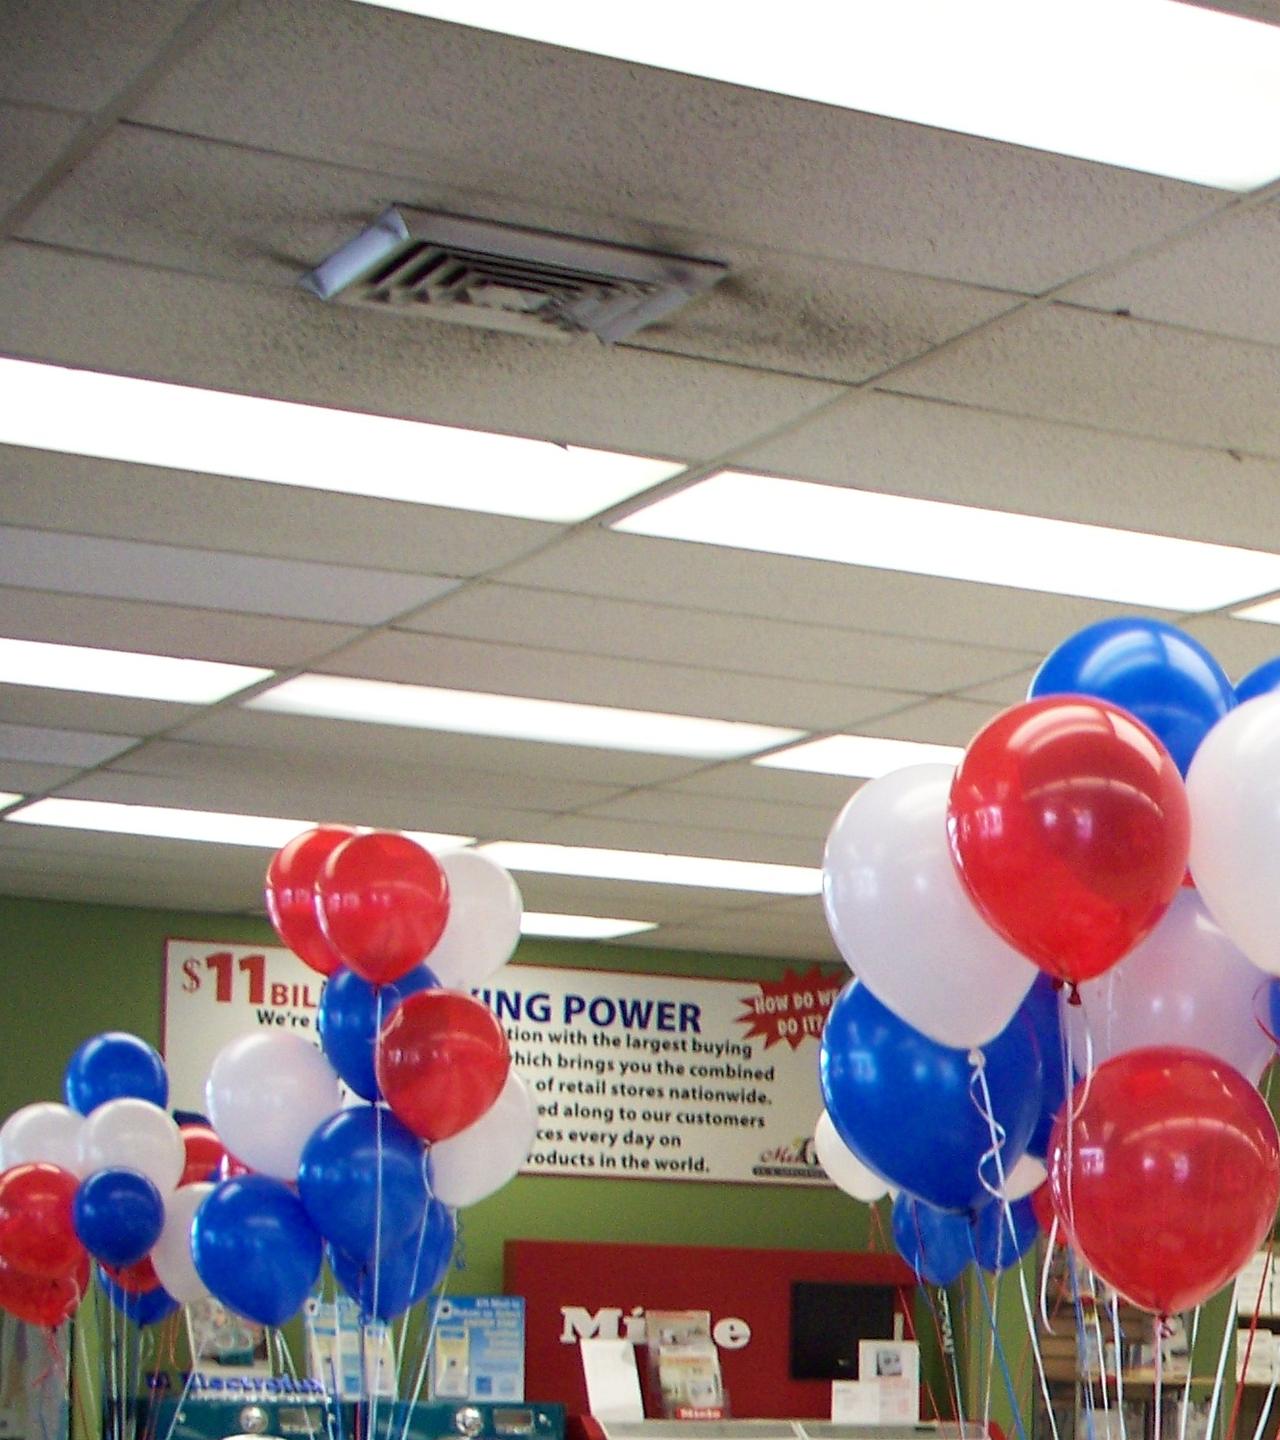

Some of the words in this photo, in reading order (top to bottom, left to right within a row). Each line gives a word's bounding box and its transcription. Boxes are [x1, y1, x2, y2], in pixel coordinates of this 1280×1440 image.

[181, 952, 266, 1005] $11
[271, 982, 325, 1009] BIL
[471, 987, 551, 1022] ING
[564, 993, 702, 1034] POWER
[755, 994, 788, 1014] HOW
[794, 992, 814, 1009] DO
[257, 1009, 310, 1028] We're
[507, 1027, 542, 1043] tion
[549, 1029, 587, 1046] with
[593, 1033, 621, 1048] the
[626, 1033, 686, 1054] largest
[692, 1038, 752, 1059] buying
[777, 1018, 798, 1036] DO
[511, 1051, 552, 1068] hich
[557, 1055, 615, 1072] brings
[619, 1060, 651, 1076] you
[656, 1061, 685, 1076] the
[689, 1064, 776, 1082] combined
[536, 1078, 555, 1092] of
[558, 1079, 607, 1095] retail
[610, 1082, 664, 1098] stores
[669, 1085, 772, 1105] nationwide.
[537, 1101, 559, 1117] ed
[563, 1104, 615, 1123] along
[619, 1107, 637, 1121] to
[641, 1110, 671, 1123] our
[676, 1110, 766, 1128] customers
[536, 1129, 563, 1142] ces
[568, 1131, 618, 1147] every
[622, 1128, 655, 1149] day
[659, 1134, 682, 1148] on
[527, 1149, 596, 1168] roducts
[599, 1152, 616, 1168] in
[622, 1153, 651, 1169] the
[654, 1155, 711, 1173] world.
[559, 1304, 751, 1349] Mie
